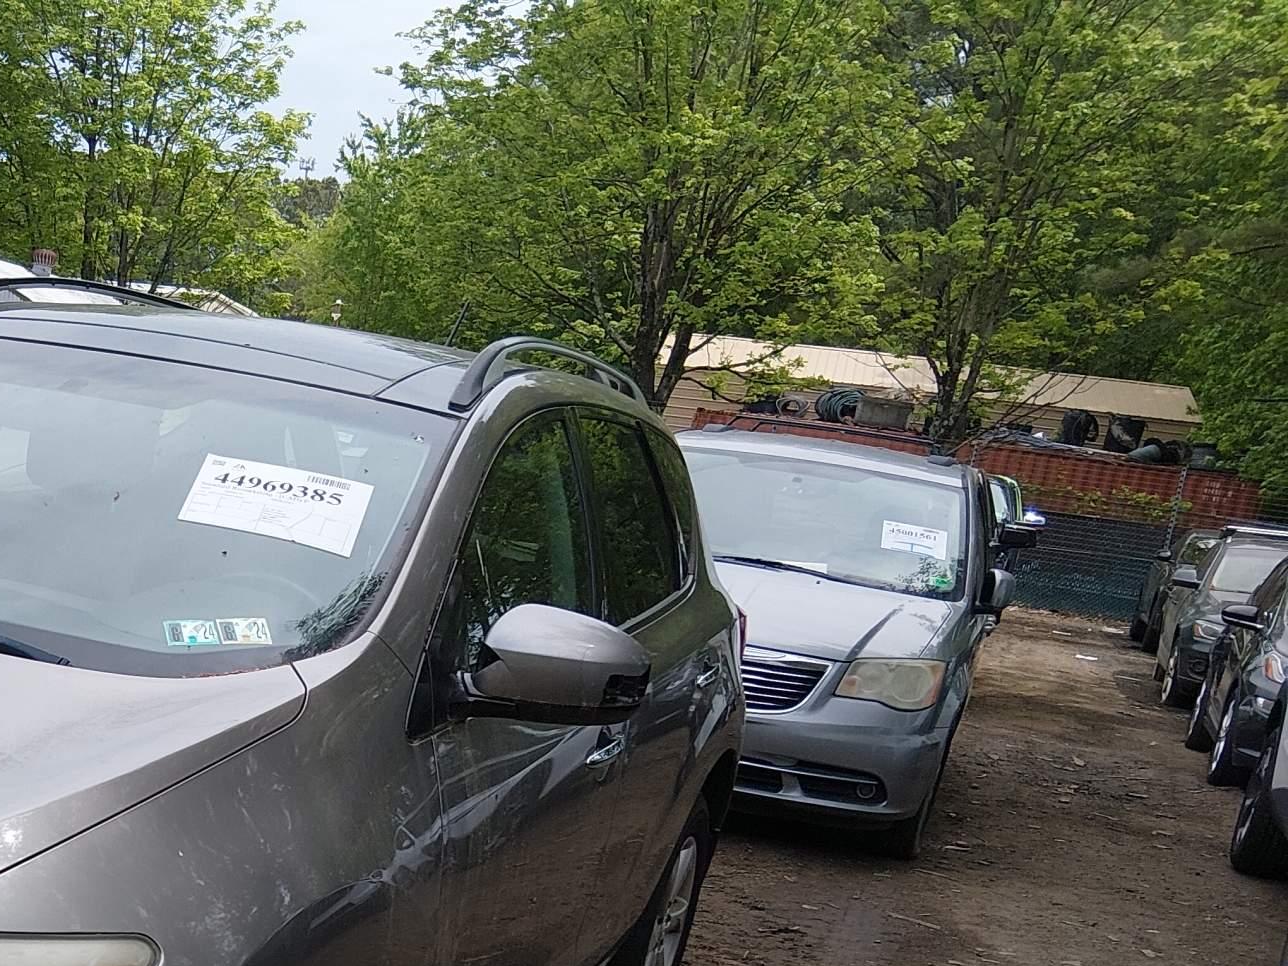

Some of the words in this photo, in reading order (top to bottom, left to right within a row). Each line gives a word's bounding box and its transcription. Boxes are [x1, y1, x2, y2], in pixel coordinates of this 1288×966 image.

[214, 471, 345, 507] 44969385
[200, 622, 216, 640] 24
[253, 621, 268, 640] 24
